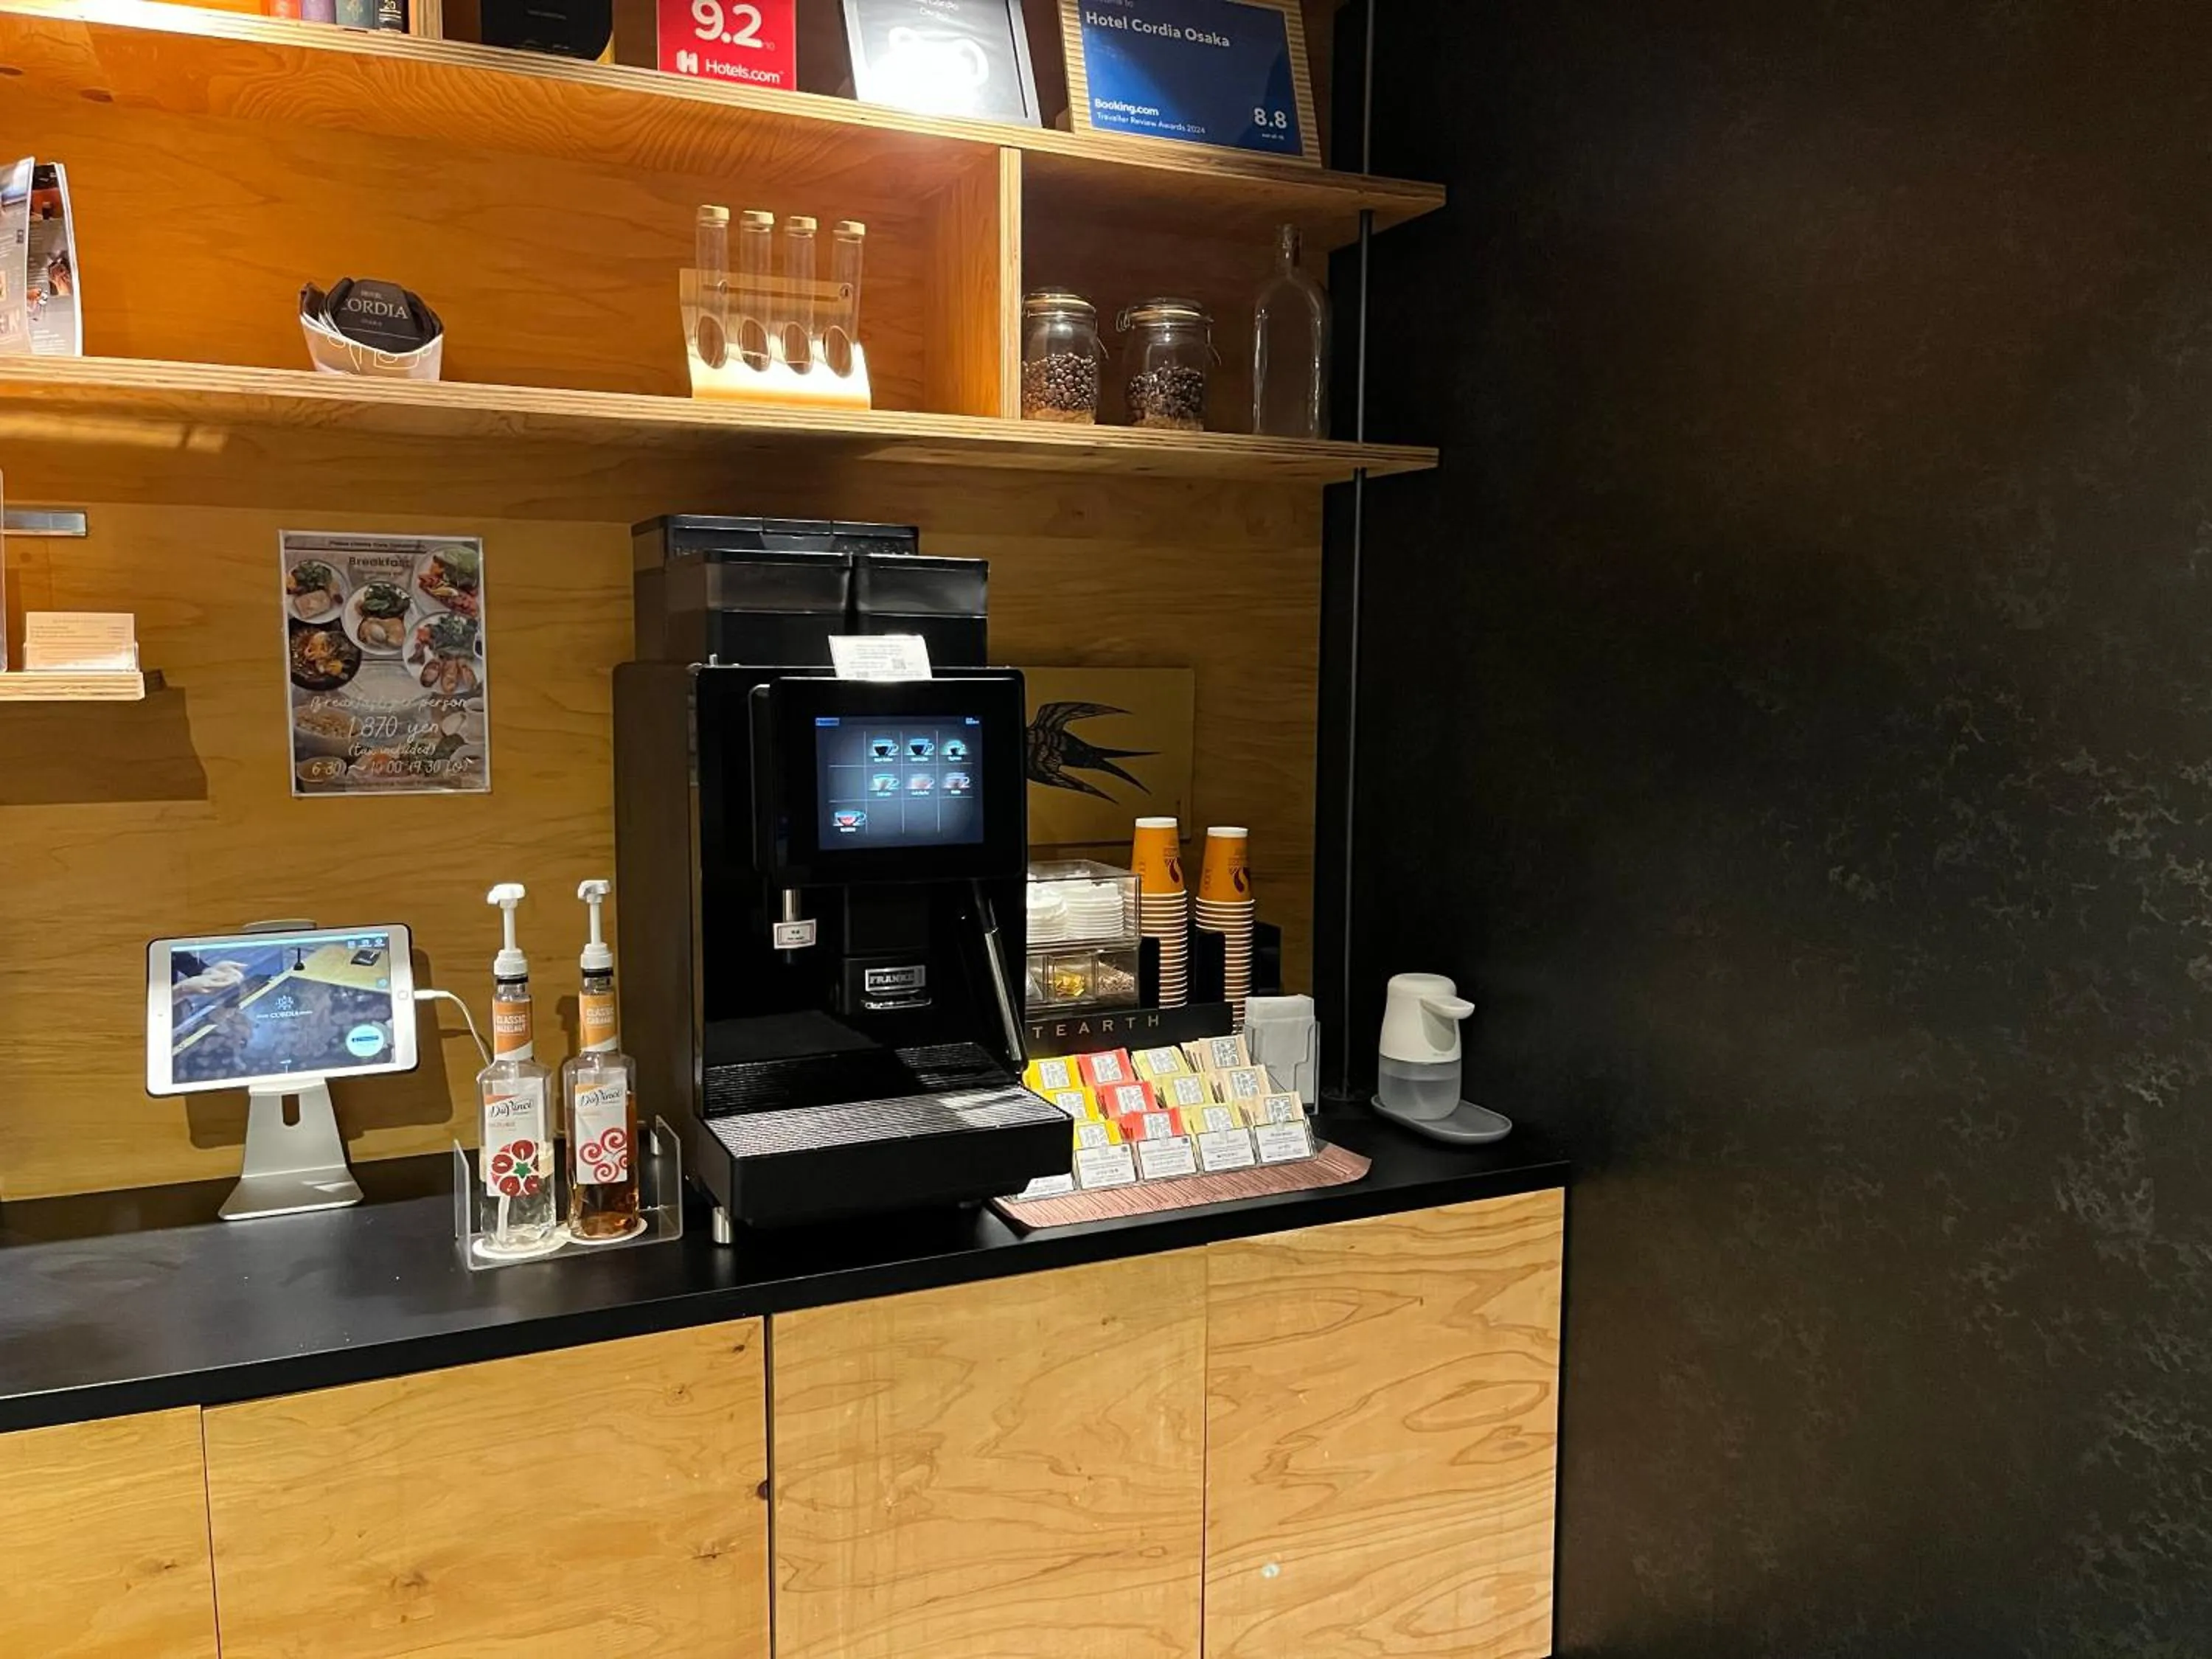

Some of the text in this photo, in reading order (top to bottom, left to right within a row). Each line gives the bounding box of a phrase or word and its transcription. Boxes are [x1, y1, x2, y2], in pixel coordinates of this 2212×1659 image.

[692, 0, 763, 48] 9.2
[1085, 11, 1231, 48] Hotel Cordia Osaka
[706, 58, 780, 83] Hotels.com
[1094, 98, 1159, 116] Booking.com
[1253, 108, 1287, 129] 8.8
[1097, 112, 1206, 133] Traveller Review Awards 2024
[407, 721, 439, 744] yen
[1032, 1015, 1160, 1039] TEARTH
[489, 1098, 533, 1118] DaVinci
